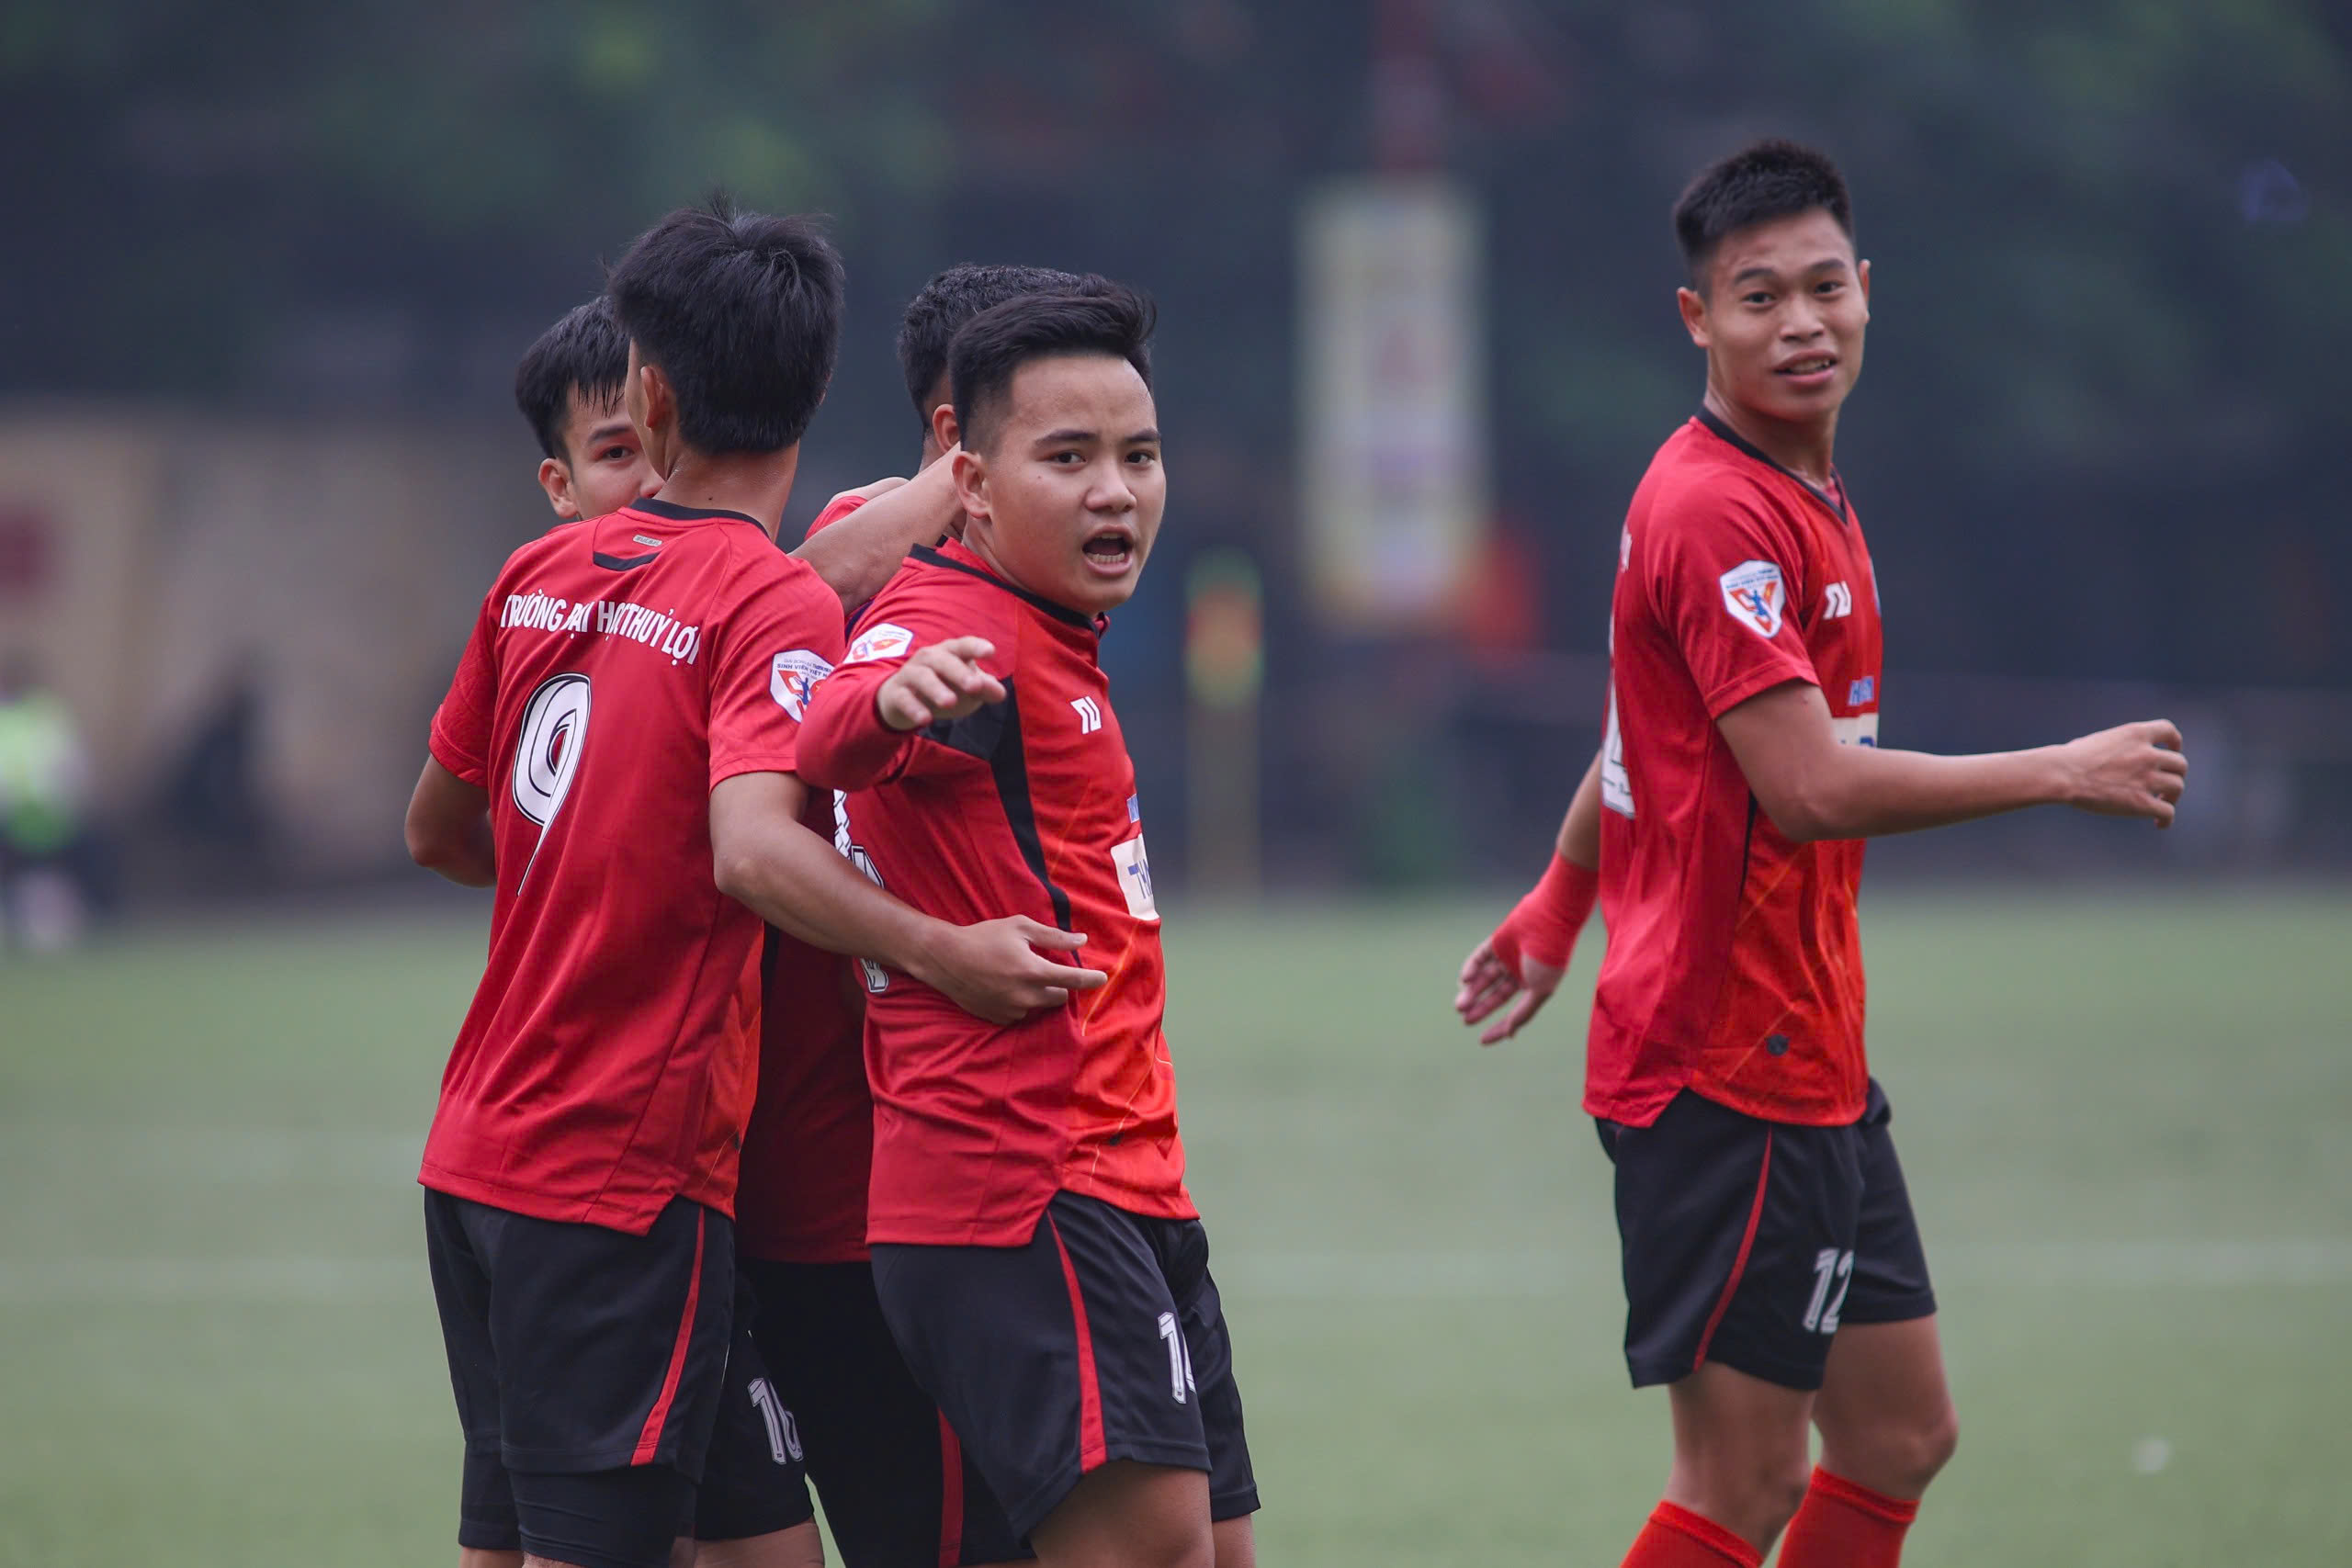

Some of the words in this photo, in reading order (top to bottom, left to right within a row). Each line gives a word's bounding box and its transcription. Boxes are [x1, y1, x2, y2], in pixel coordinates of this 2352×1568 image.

[500, 588, 567, 632] TRƯỜNG
[661, 620, 702, 665] LỢI
[511, 671, 592, 897] 9
[1802, 1247, 1854, 1335] 12
